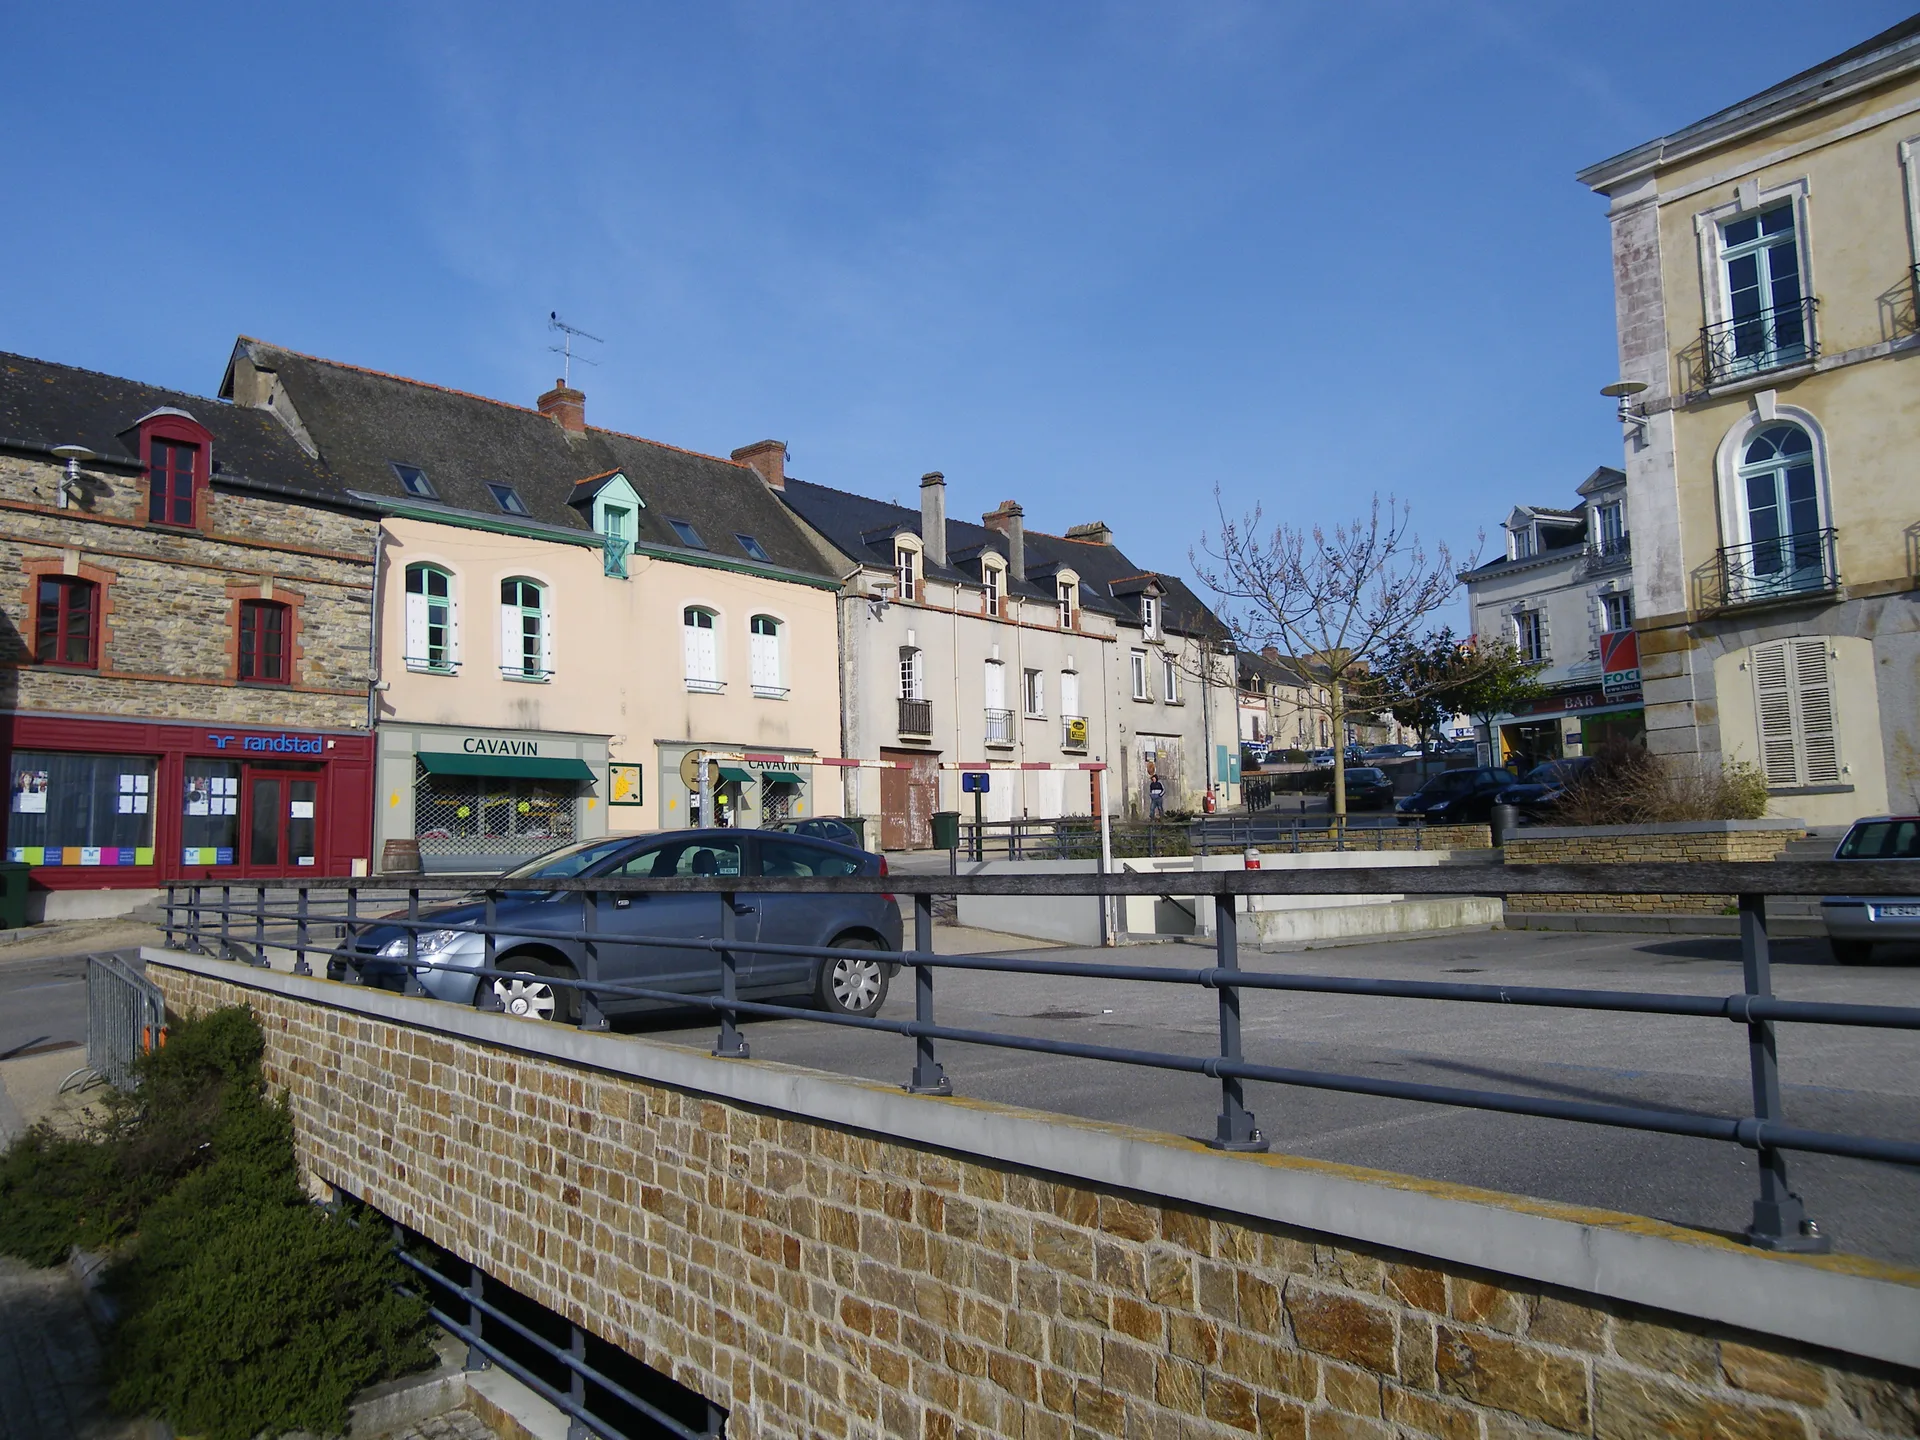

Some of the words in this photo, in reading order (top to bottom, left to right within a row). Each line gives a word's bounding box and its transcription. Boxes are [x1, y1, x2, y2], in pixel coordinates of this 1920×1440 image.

[1564, 695, 1594, 709] BAR
[243, 734, 322, 753] randstad
[463, 738, 538, 756] CAVAVIN
[748, 760, 800, 771] CAVAVIN
